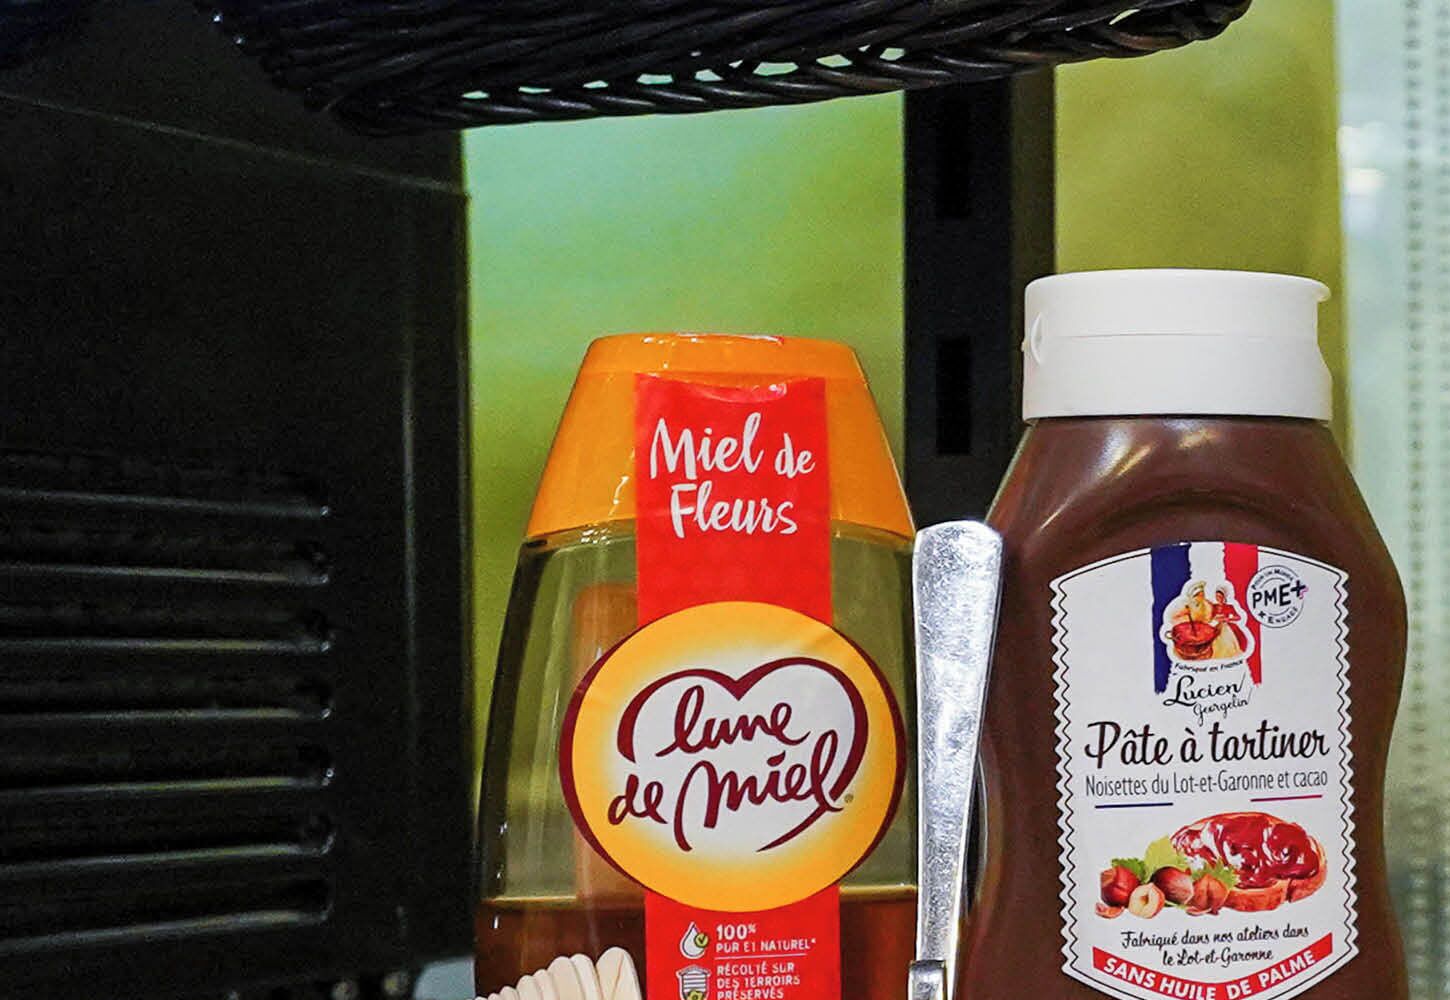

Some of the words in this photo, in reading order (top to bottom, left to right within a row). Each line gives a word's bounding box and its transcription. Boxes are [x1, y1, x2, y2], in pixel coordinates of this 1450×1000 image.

[650, 412, 764, 480] Miel
[774, 432, 816, 479] de
[670, 480, 798, 539] Fleurs
[1163, 671, 1247, 707] Lucien
[1084, 721, 1174, 769] Pâte
[1180, 727, 1203, 763] à
[1207, 720, 1330, 763] tartiner
[1086, 774, 1148, 797] Noisettes
[1151, 773, 1170, 795] du
[1173, 769, 1274, 793] Lot-et-Garonne
[1277, 770, 1290, 788] et
[1293, 769, 1328, 787] cacao
[608, 774, 668, 826] de
[716, 942, 739, 954] PUR
[743, 941, 756, 953] ET
[1120, 930, 1179, 949] Fabriqué
[1181, 928, 1210, 945] dans
[1213, 931, 1232, 944] nos
[1236, 926, 1280, 942] ateliers
[1283, 923, 1309, 939] dans
[772, 962, 795, 974] SUR
[1162, 952, 1175, 967] le
[1177, 949, 1275, 968] Lot-et-Garonne
[717, 977, 738, 989] DES
[745, 975, 800, 988] TERROIRS
[1104, 957, 1155, 987] SANS
[1226, 981, 1253, 1000] DE
[1259, 950, 1316, 989] PALME
